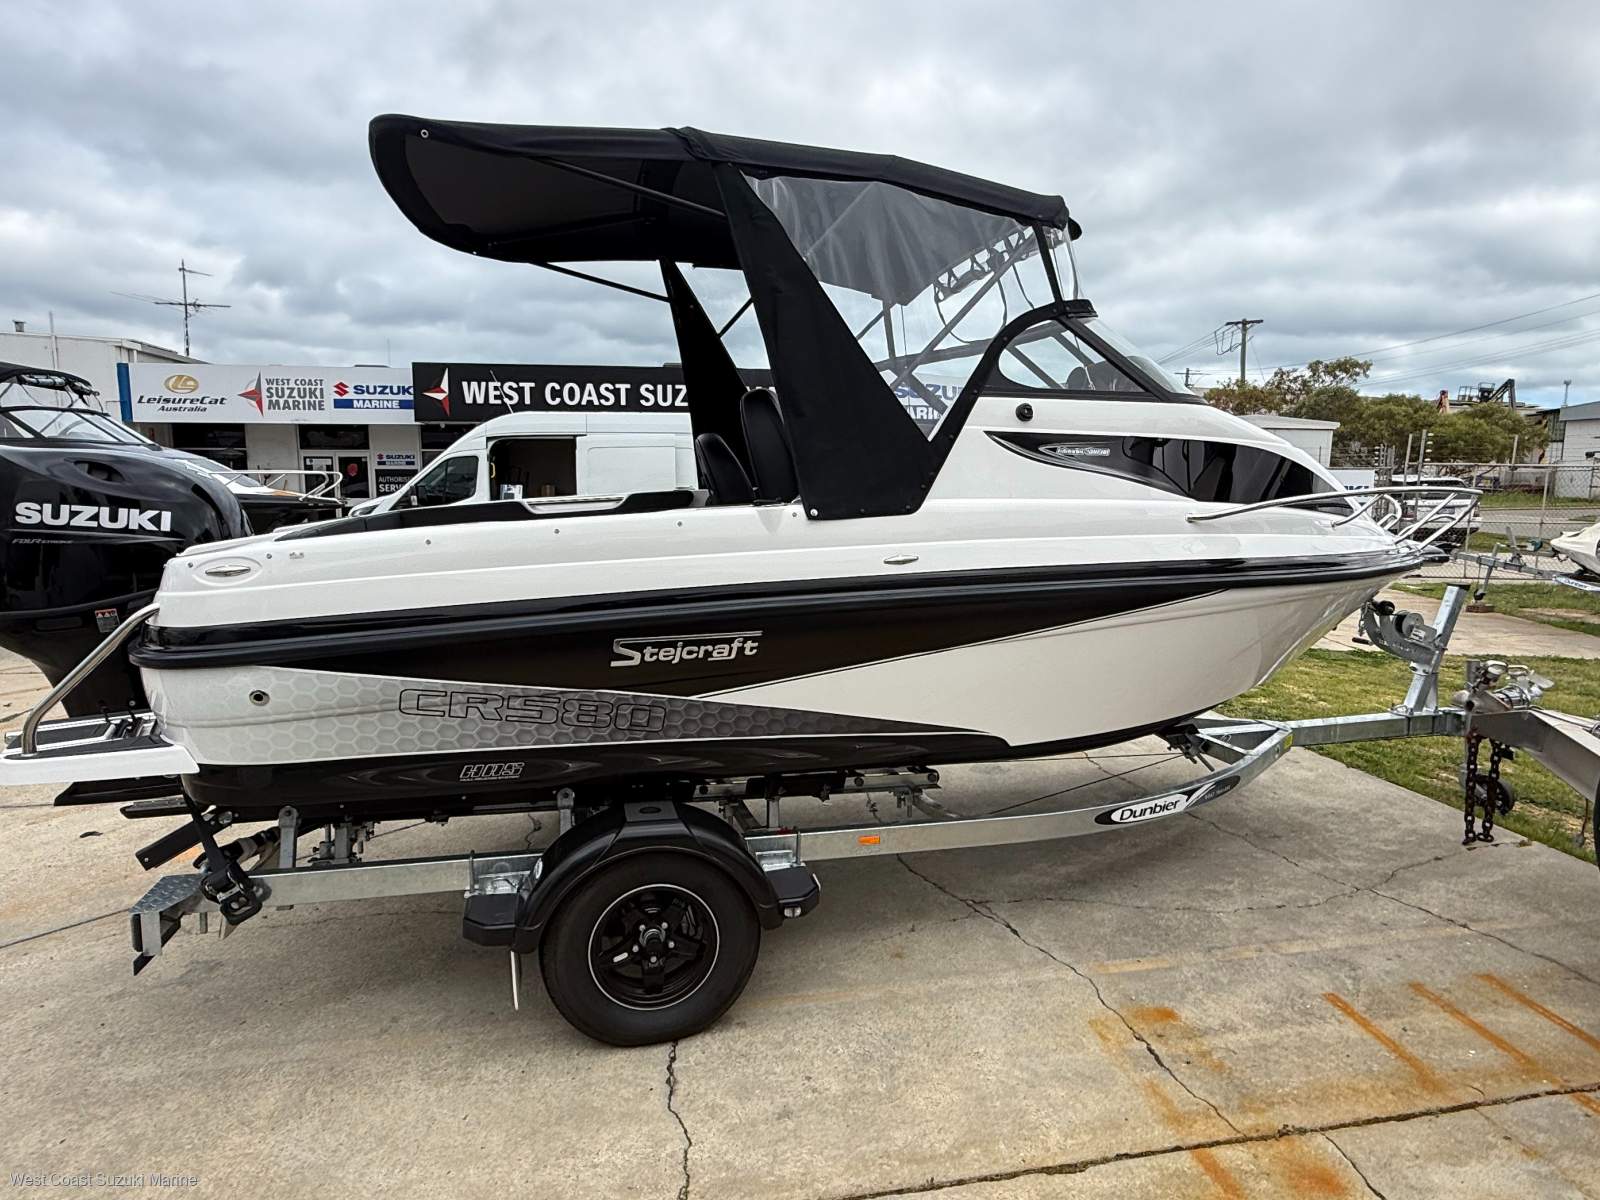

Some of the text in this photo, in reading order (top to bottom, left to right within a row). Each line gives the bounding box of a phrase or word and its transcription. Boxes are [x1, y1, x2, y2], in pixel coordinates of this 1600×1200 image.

[295, 379, 324, 387] COAST
[266, 387, 325, 399] SUZUKI
[353, 384, 414, 396] SUZUK
[462, 381, 689, 407] WEST COAST SUZ
[137, 395, 227, 405] LeisureCat
[267, 399, 325, 411] MARINE
[353, 400, 400, 409] MARINE
[379, 484, 402, 492] SERV
[15, 502, 172, 532] SUZUKI
[610, 630, 763, 667] Stejcraft
[399, 689, 666, 732] CR580
[1119, 800, 1180, 821] Dunbier
